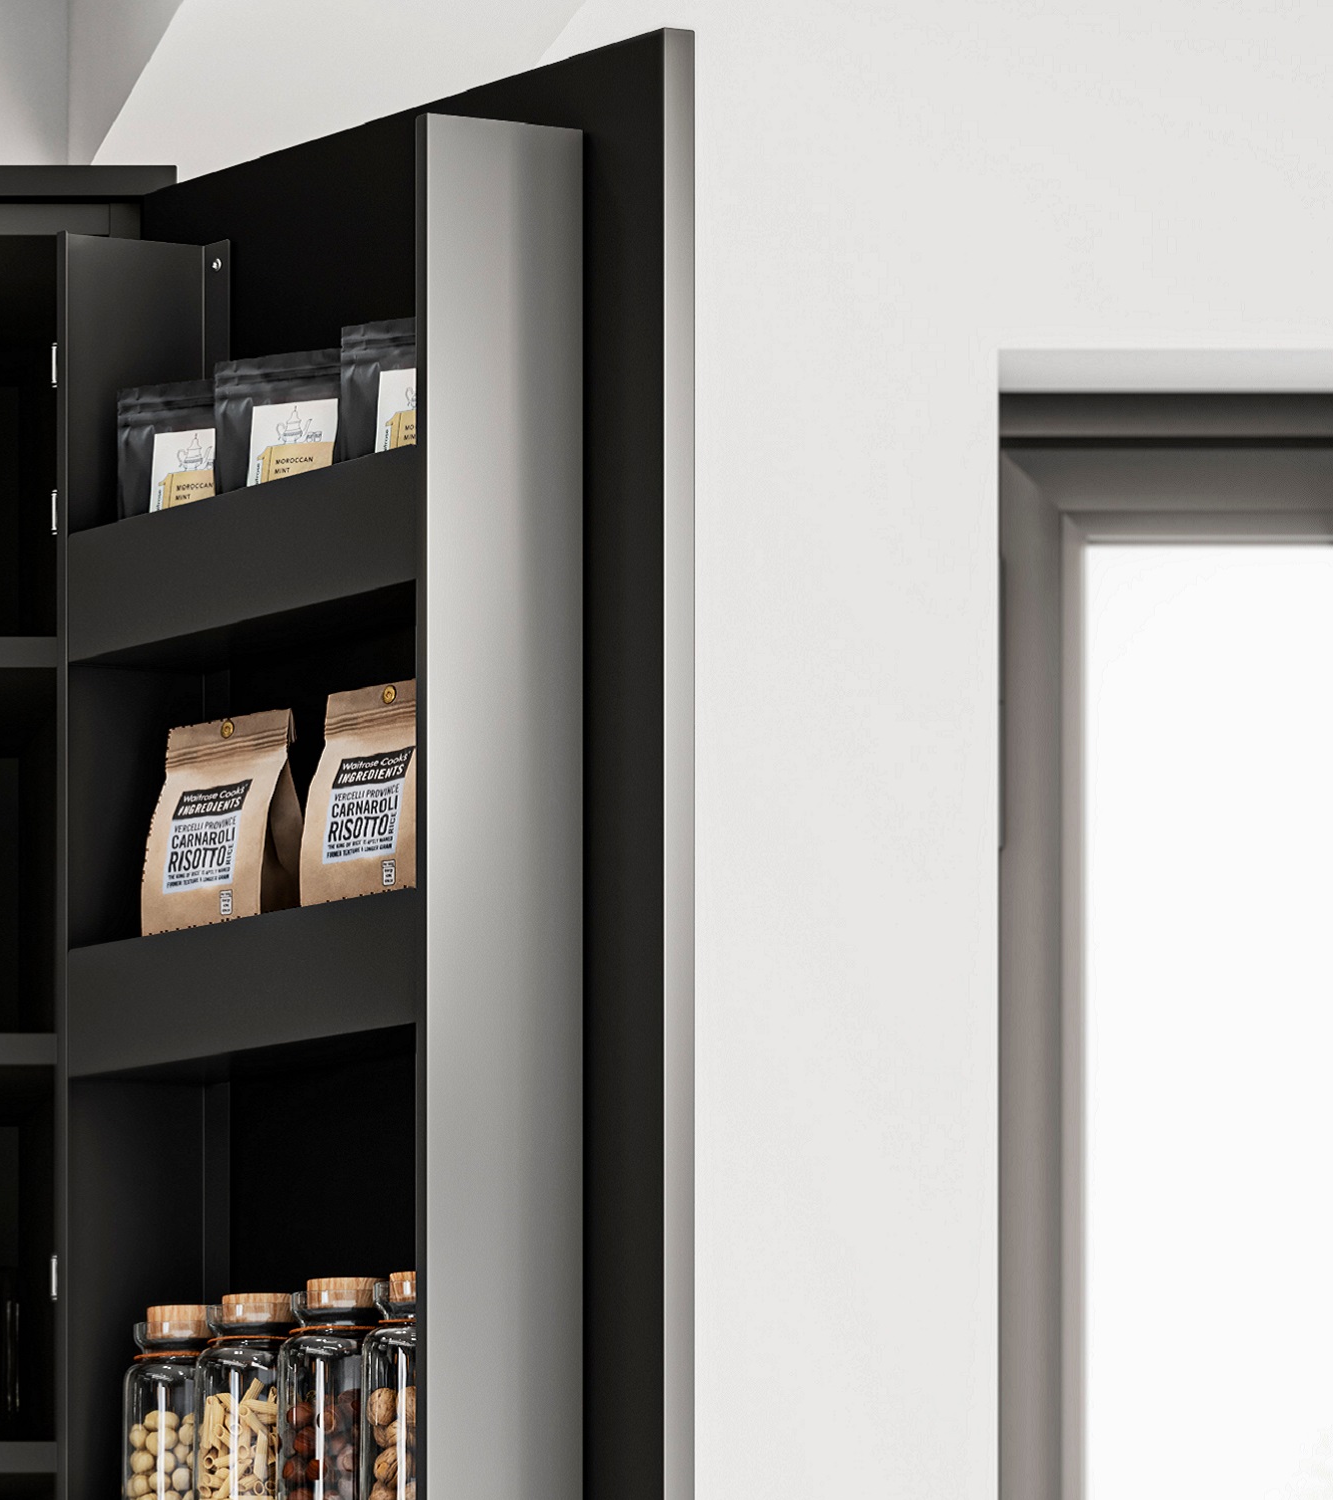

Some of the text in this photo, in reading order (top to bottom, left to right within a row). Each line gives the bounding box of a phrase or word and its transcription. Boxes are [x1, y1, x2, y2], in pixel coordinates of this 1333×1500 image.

[275, 456, 314, 465] MOROCCAN
[176, 482, 214, 491] MOROCCAN
[338, 764, 405, 784] INGREDIENTS
[342, 760, 379, 771] Waitrose
[183, 791, 219, 803] Waitrose
[334, 783, 400, 802] VERCELLI PROVINCE
[177, 797, 242, 816] INGREDIENTS
[331, 795, 399, 818] CARNAROLI
[174, 816, 237, 833] VERCELLI PROVINCE
[328, 813, 389, 843] RISOTTO
[388, 812, 397, 834] RICE
[171, 827, 235, 849] CARNAROLI
[167, 845, 227, 873] RISOTTO
